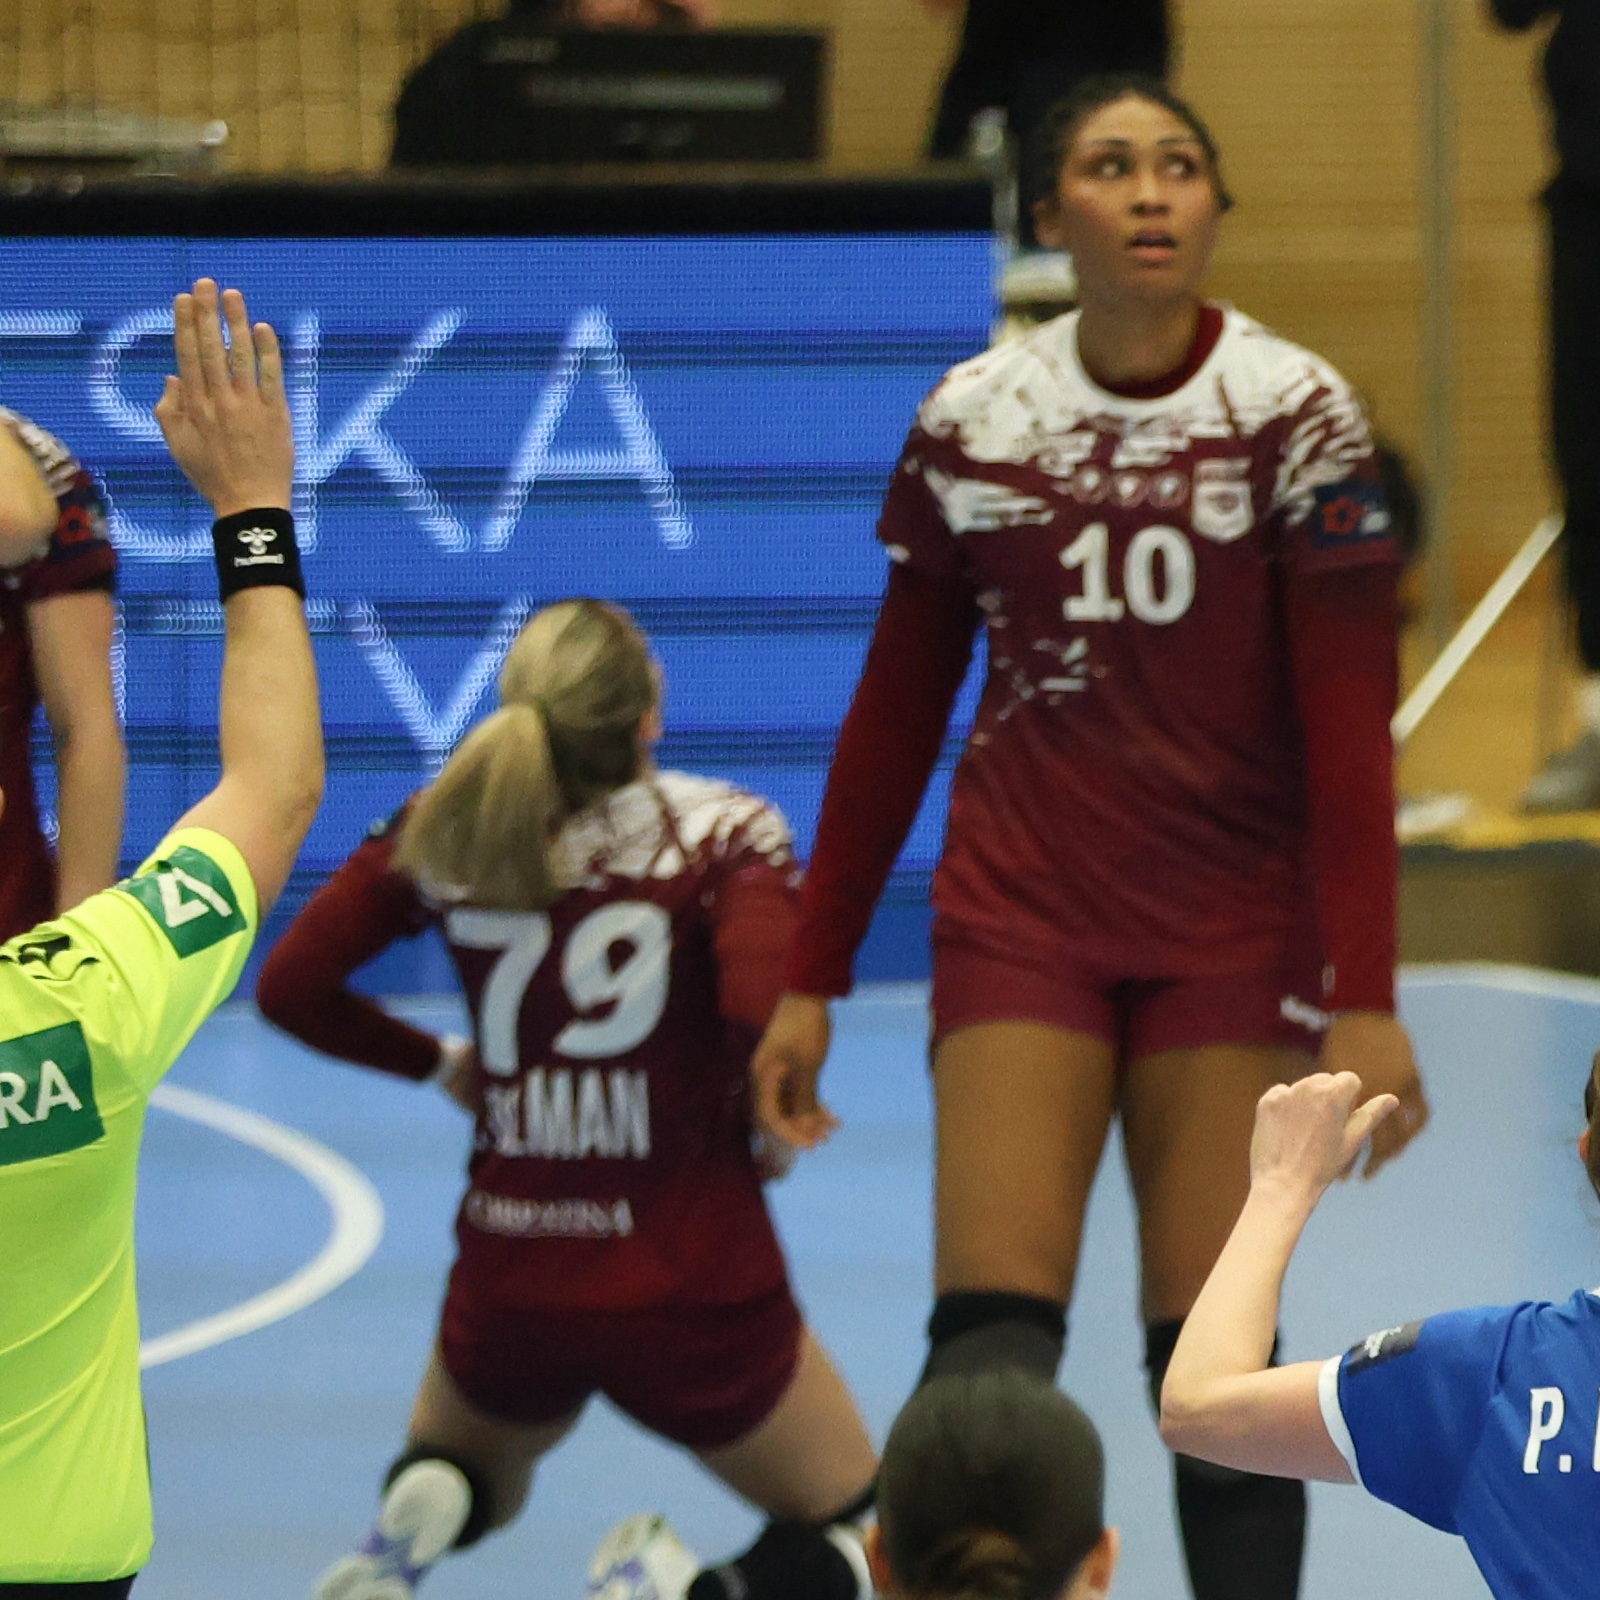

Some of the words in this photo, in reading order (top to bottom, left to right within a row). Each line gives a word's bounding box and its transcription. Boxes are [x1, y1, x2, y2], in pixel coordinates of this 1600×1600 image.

[1059, 522, 1196, 625] 10
[445, 901, 673, 1077] 79
[1522, 1388, 1572, 1474] P.
